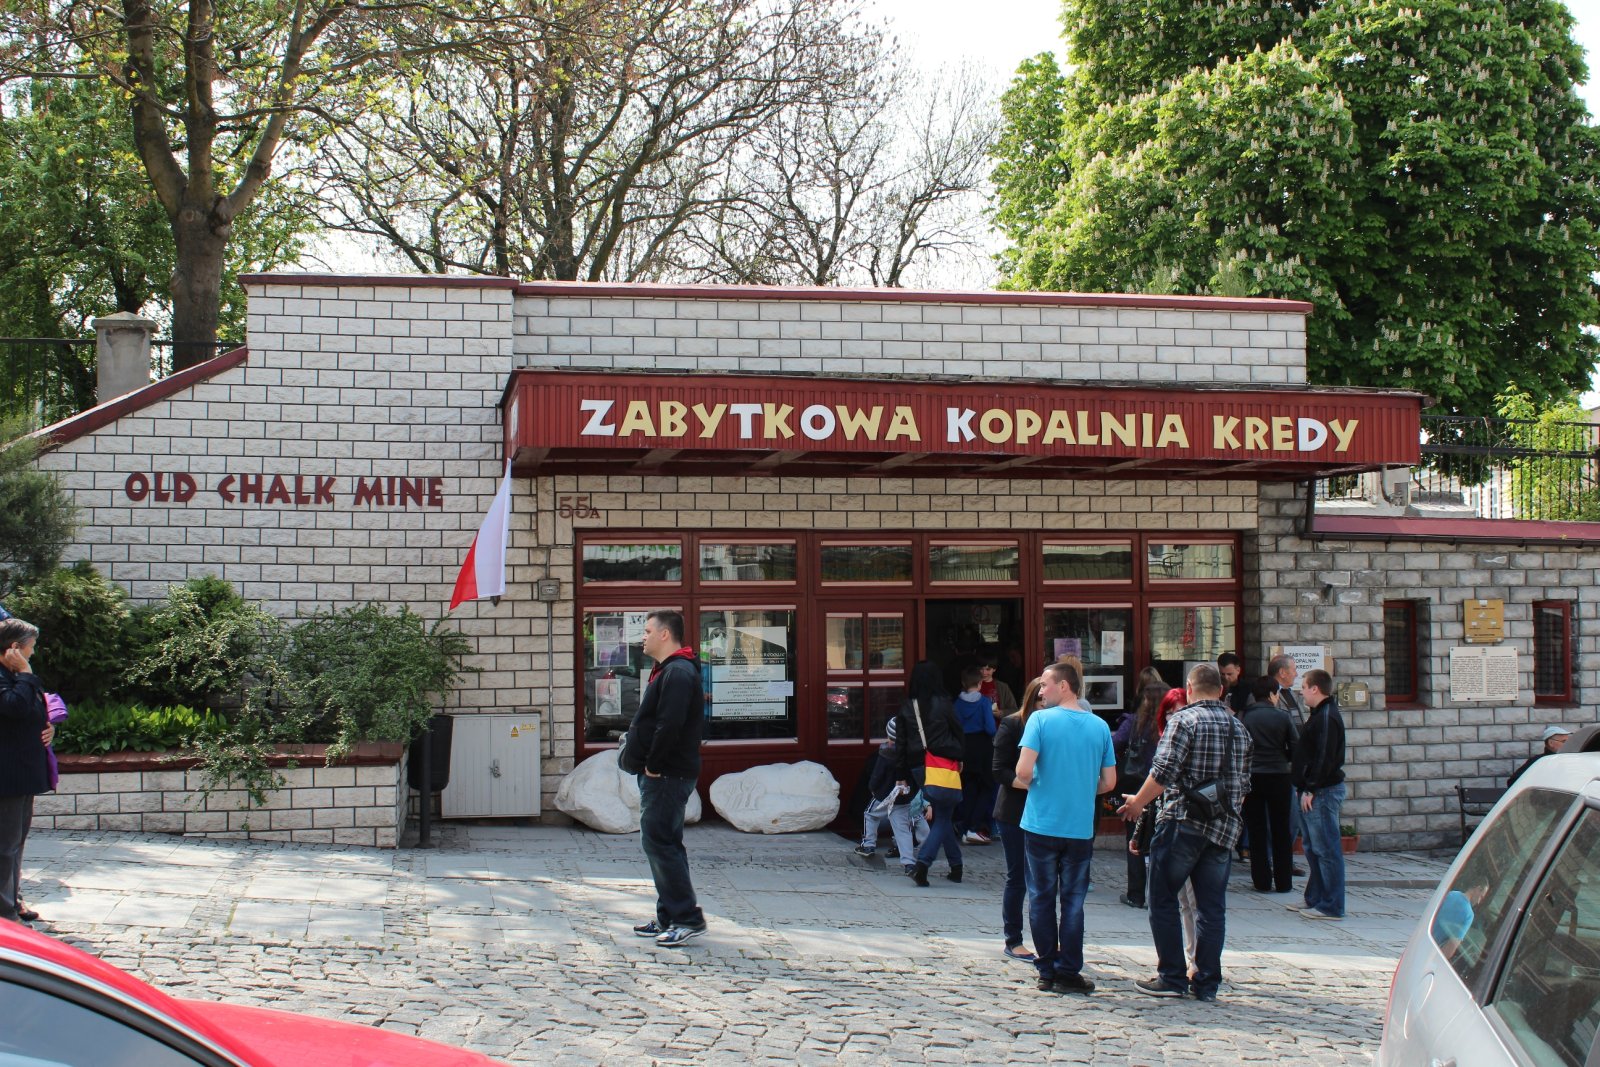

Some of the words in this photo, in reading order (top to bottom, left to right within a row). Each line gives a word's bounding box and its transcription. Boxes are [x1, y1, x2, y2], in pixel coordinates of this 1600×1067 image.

[580, 399, 922, 442] ZABYTKOWA
[946, 407, 1190, 449] KOPALNIA
[1212, 415, 1359, 452] KREDY
[125, 472, 197, 502] OLD
[217, 473, 336, 504] CHALK
[353, 476, 443, 507] MINE
